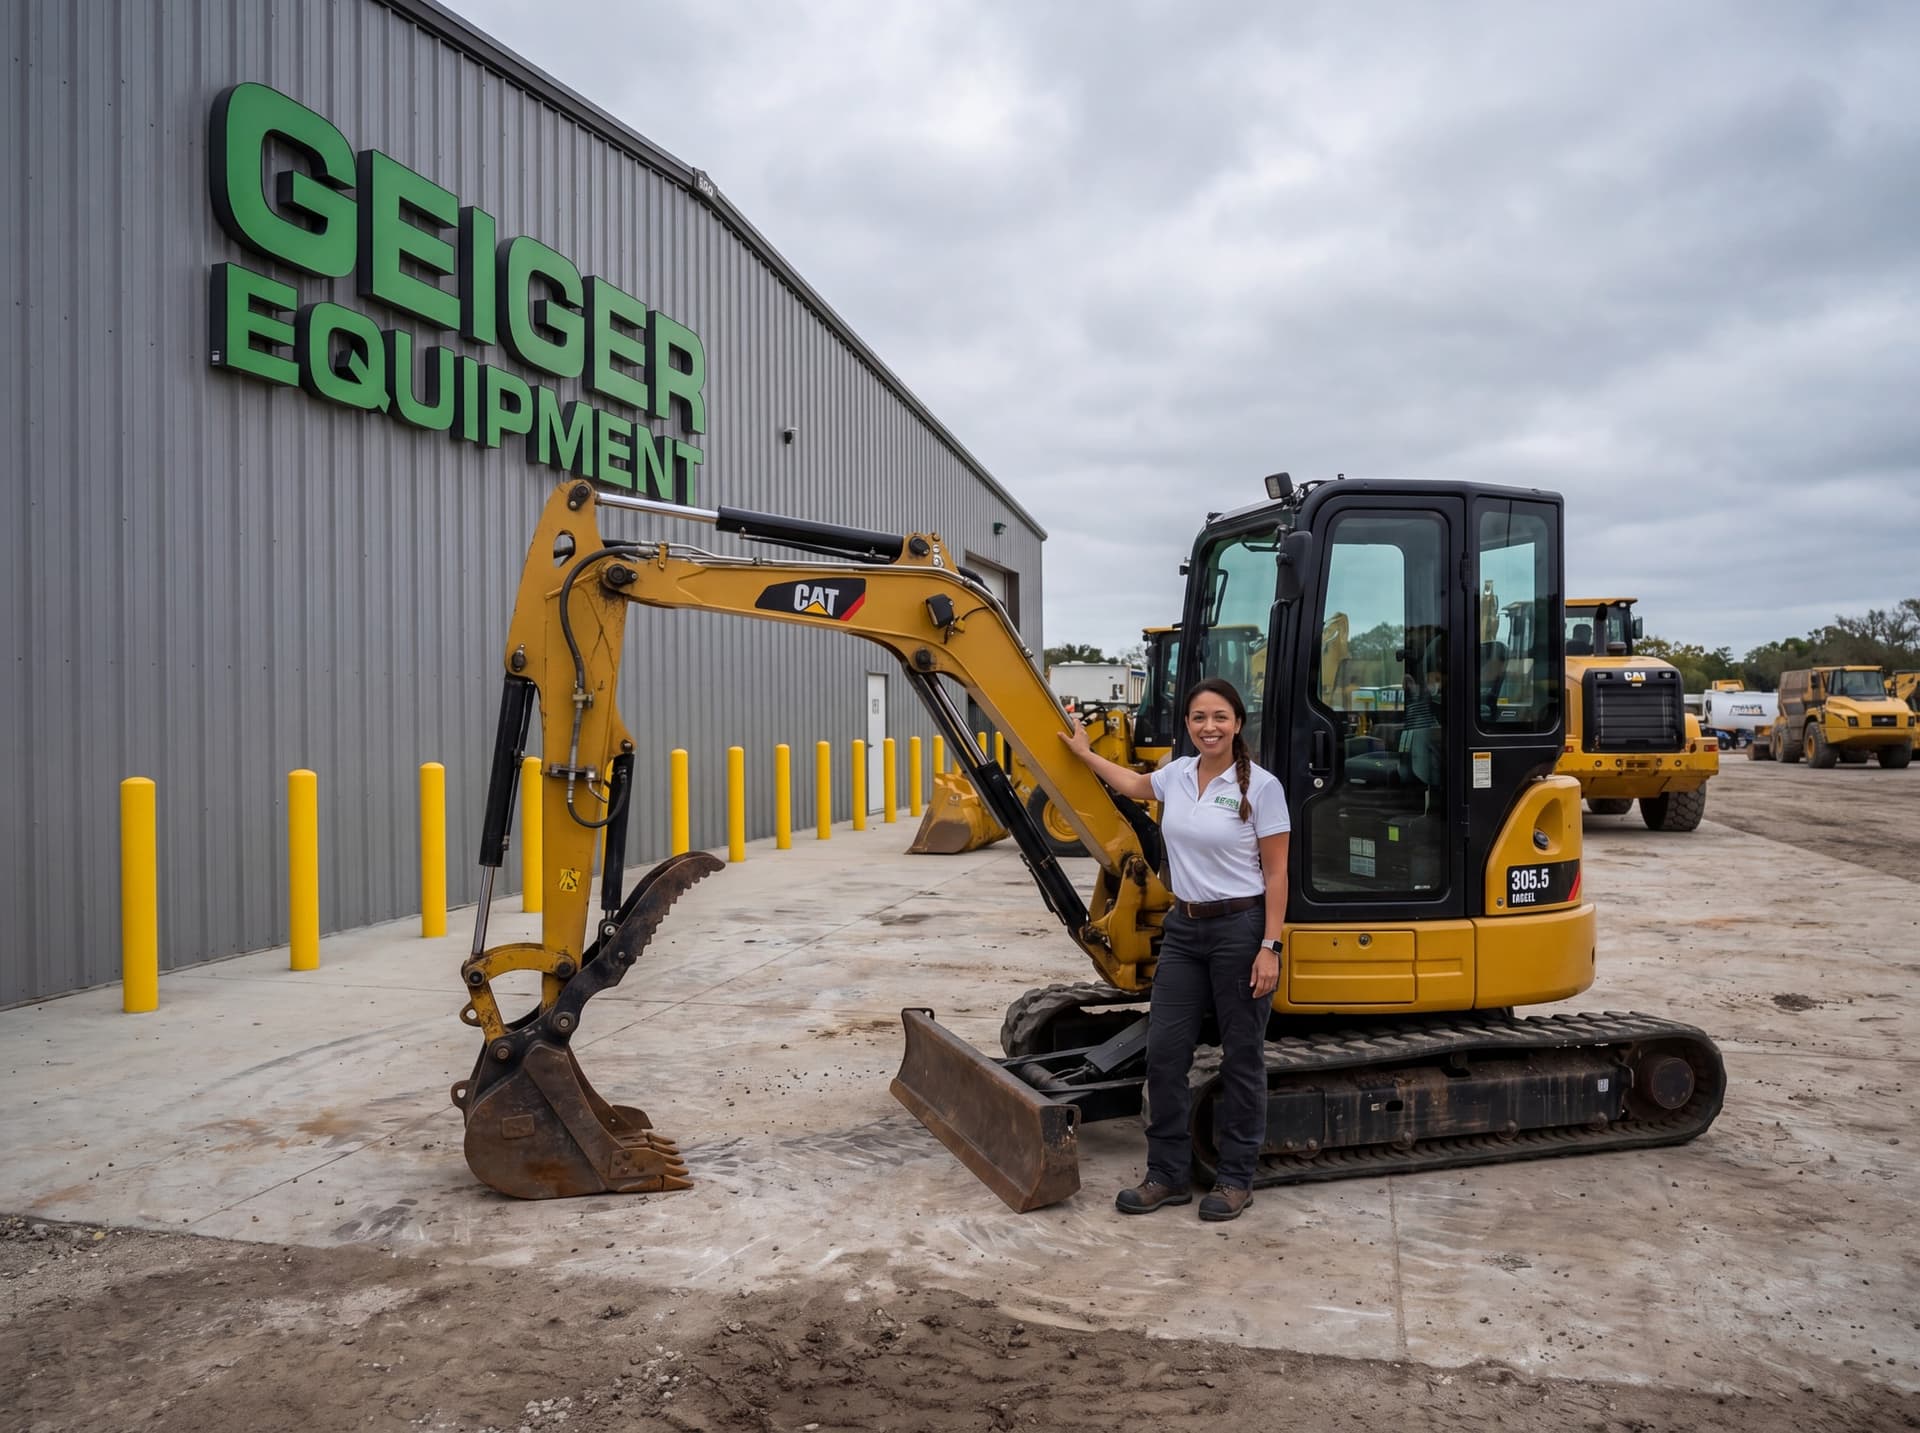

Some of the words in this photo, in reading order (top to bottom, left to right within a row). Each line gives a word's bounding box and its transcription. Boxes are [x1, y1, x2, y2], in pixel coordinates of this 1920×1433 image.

[211, 82, 706, 435] GEIGER
[212, 262, 705, 506] EQUIPMENT
[793, 583, 840, 617] CAT
[1511, 867, 1550, 891] 305.5
